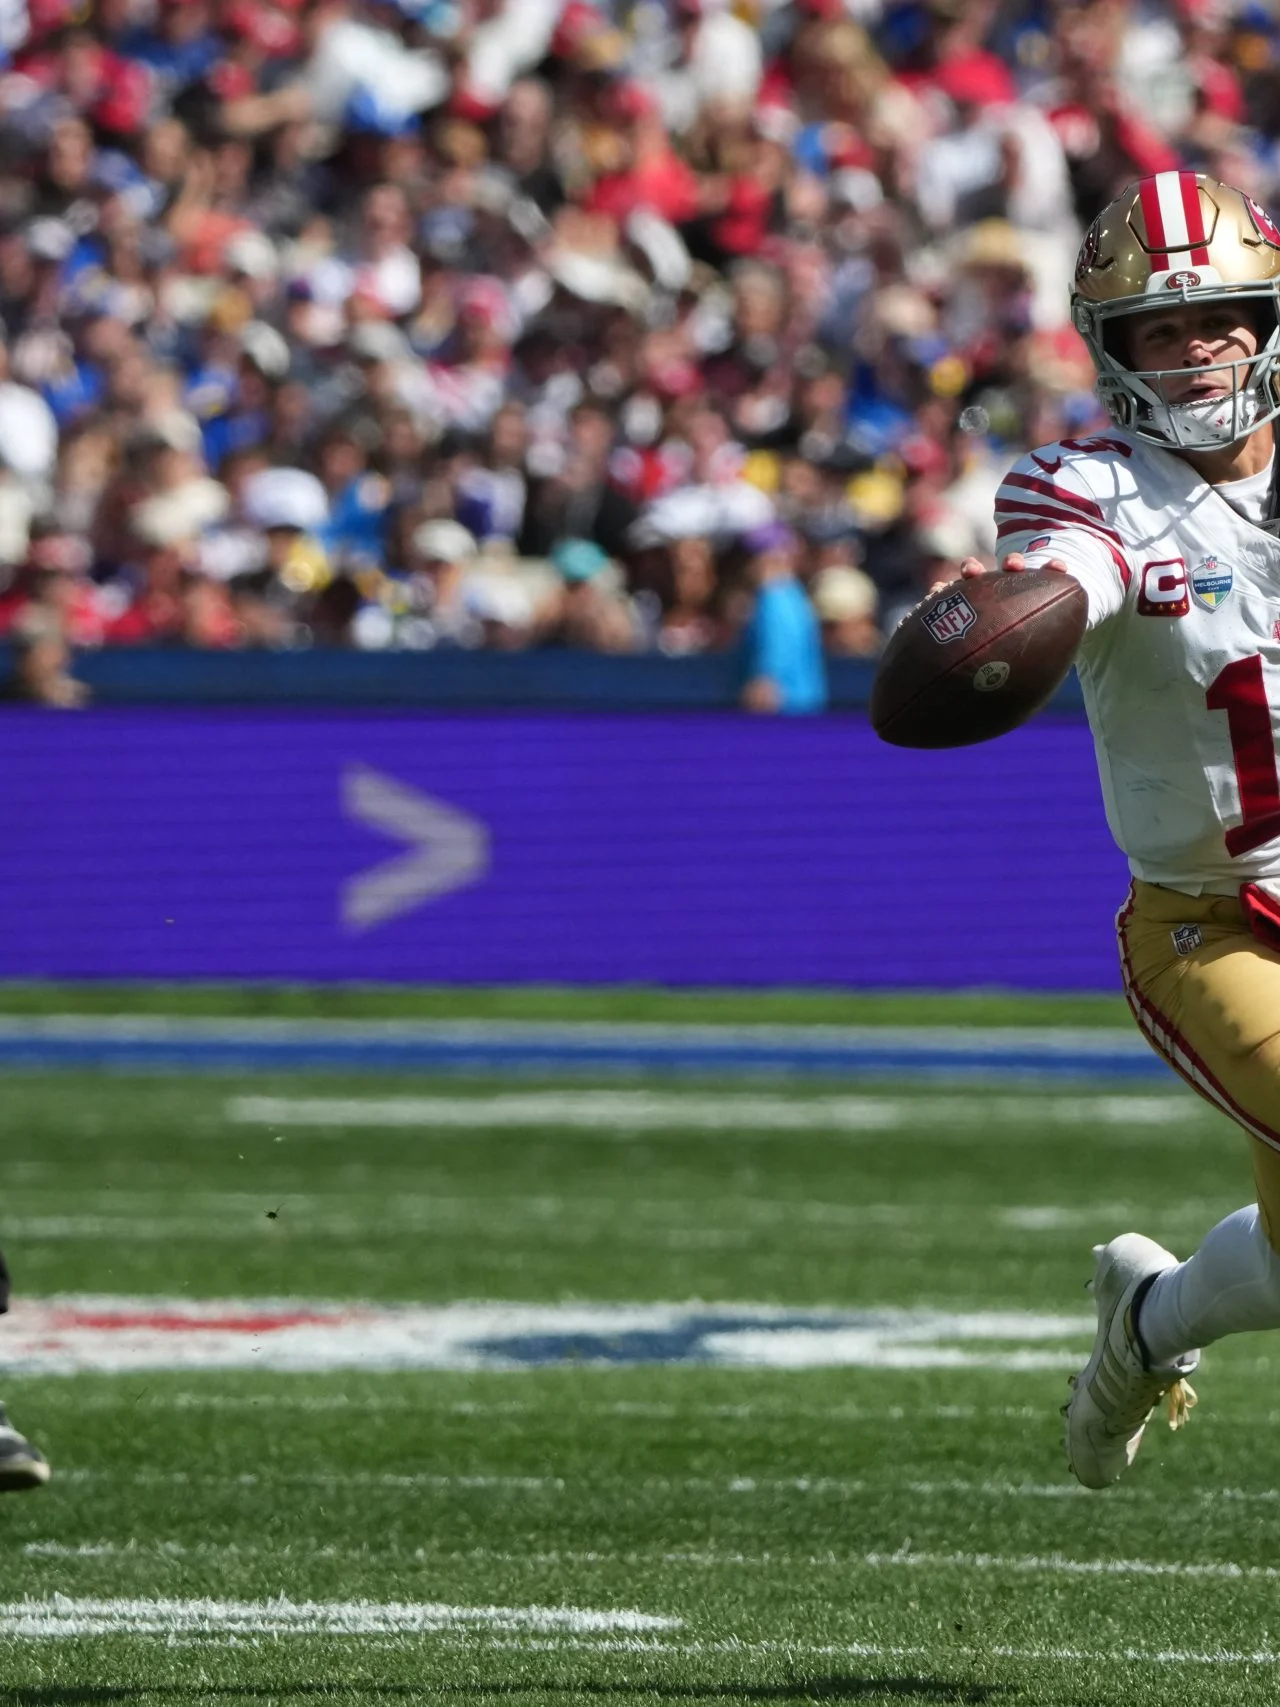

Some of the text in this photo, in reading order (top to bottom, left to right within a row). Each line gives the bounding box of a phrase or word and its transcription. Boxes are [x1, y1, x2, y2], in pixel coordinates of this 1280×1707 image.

[1144, 562, 1186, 603] C
[1195, 578, 1232, 588] MELBOURNE
[933, 606, 972, 638] NFL
